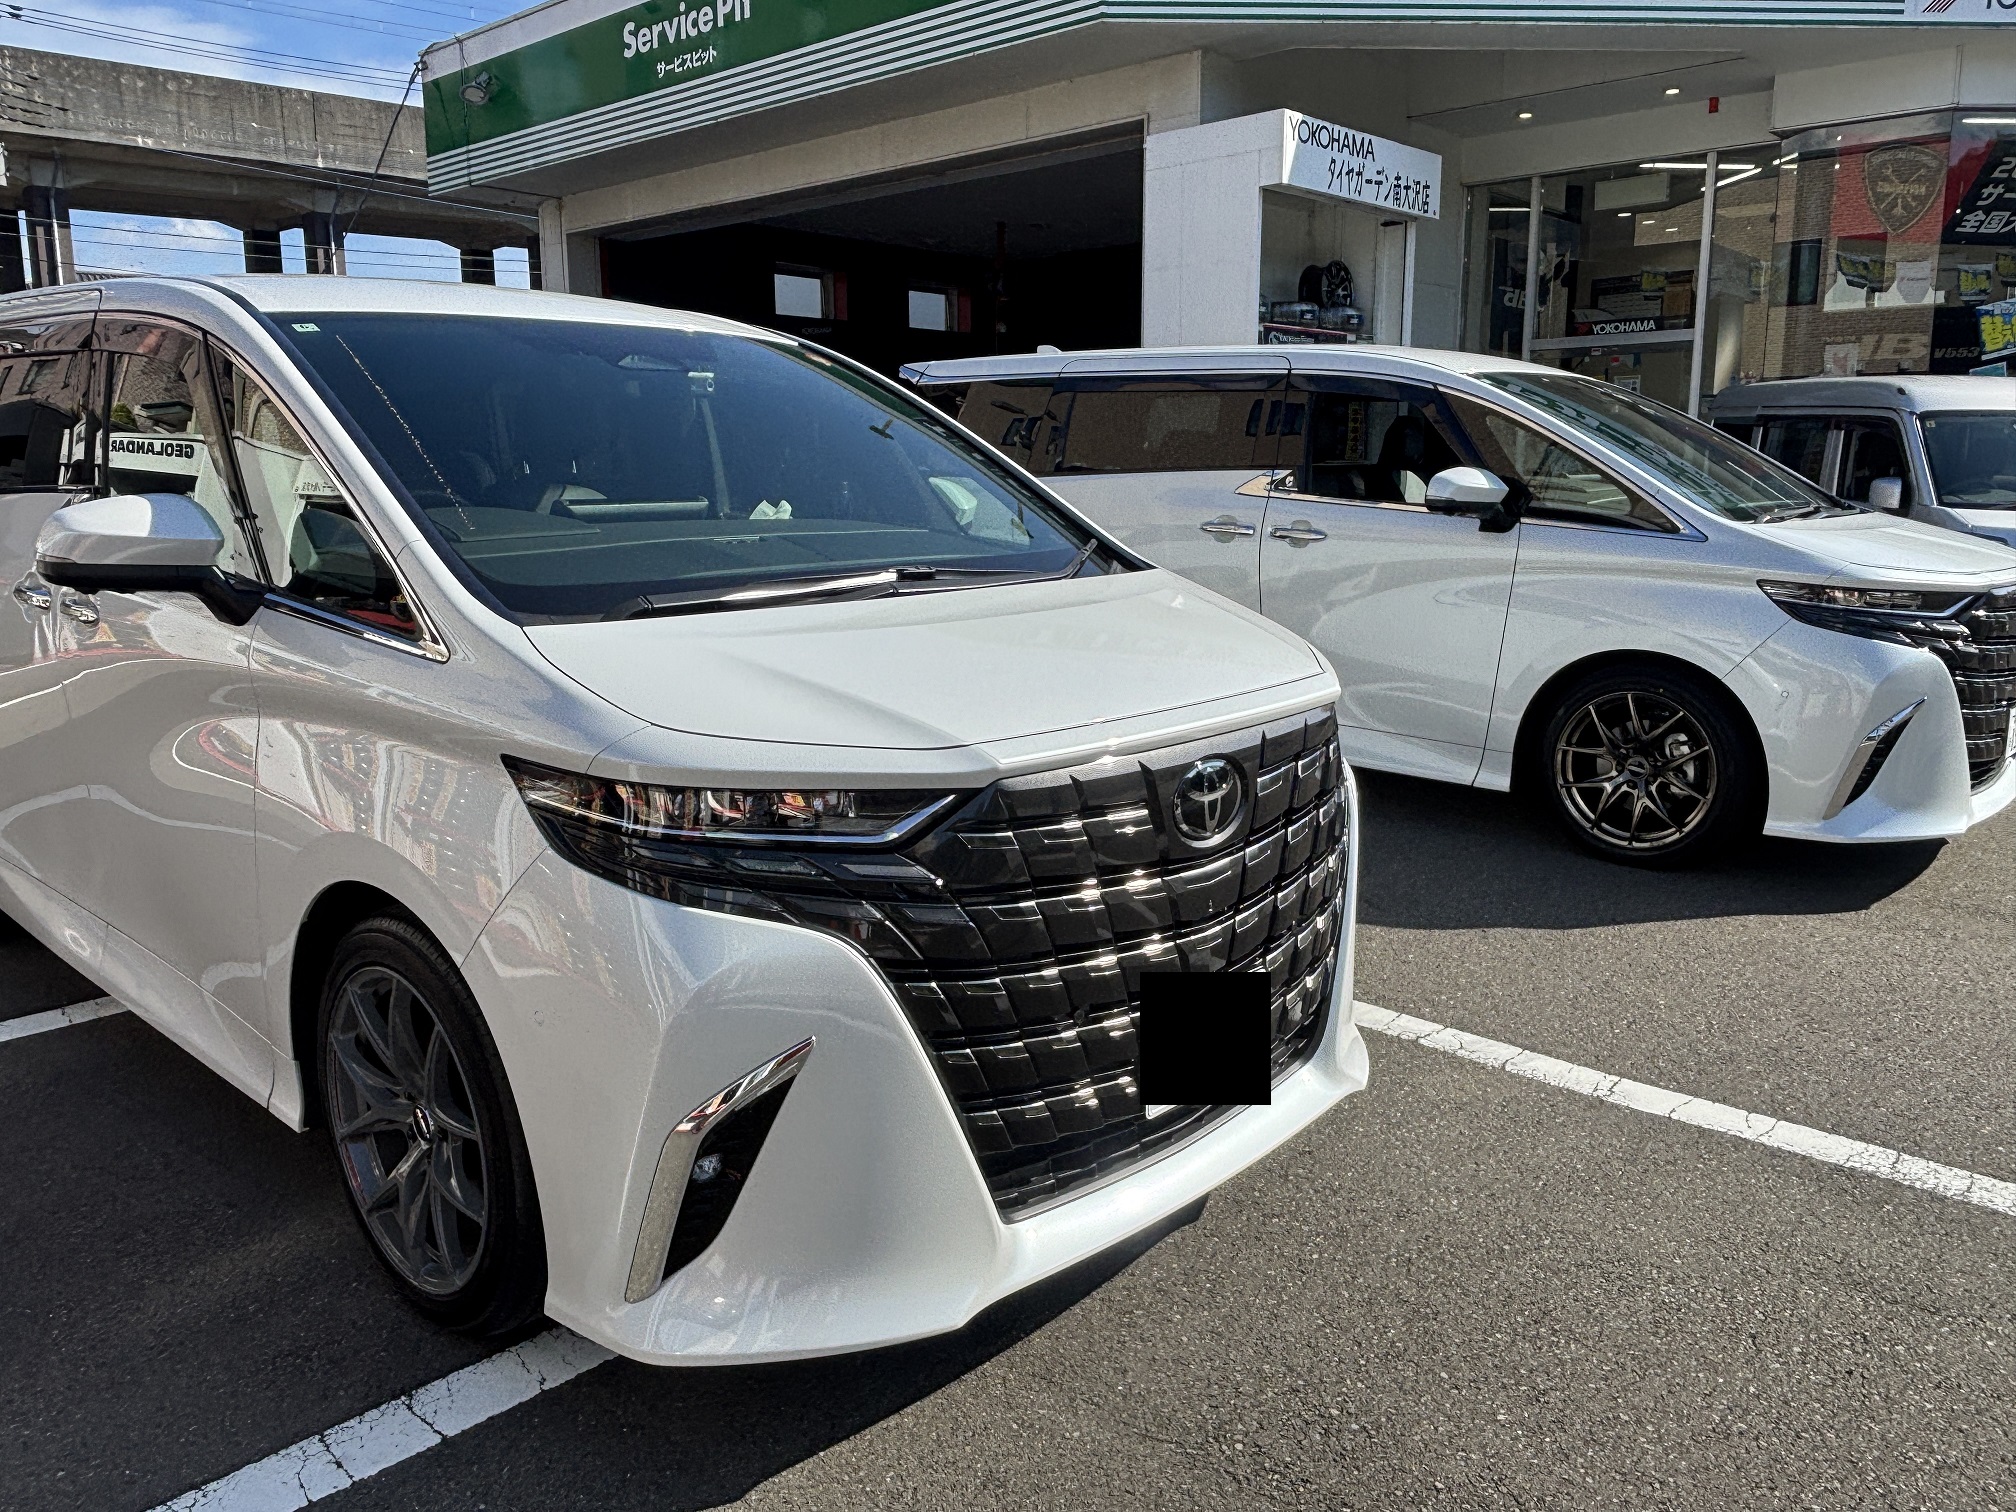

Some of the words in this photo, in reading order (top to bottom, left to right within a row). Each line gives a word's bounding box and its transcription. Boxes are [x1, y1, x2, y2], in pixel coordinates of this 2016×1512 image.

[623, 1, 714, 58] Service
[1288, 115, 1376, 163] YOKOHAMA
[1327, 156, 1431, 214] タイヤガーデン南大沢店
[1990, 156, 2016, 178] 2
[1591, 319, 1656, 335] YOKOHAMA
